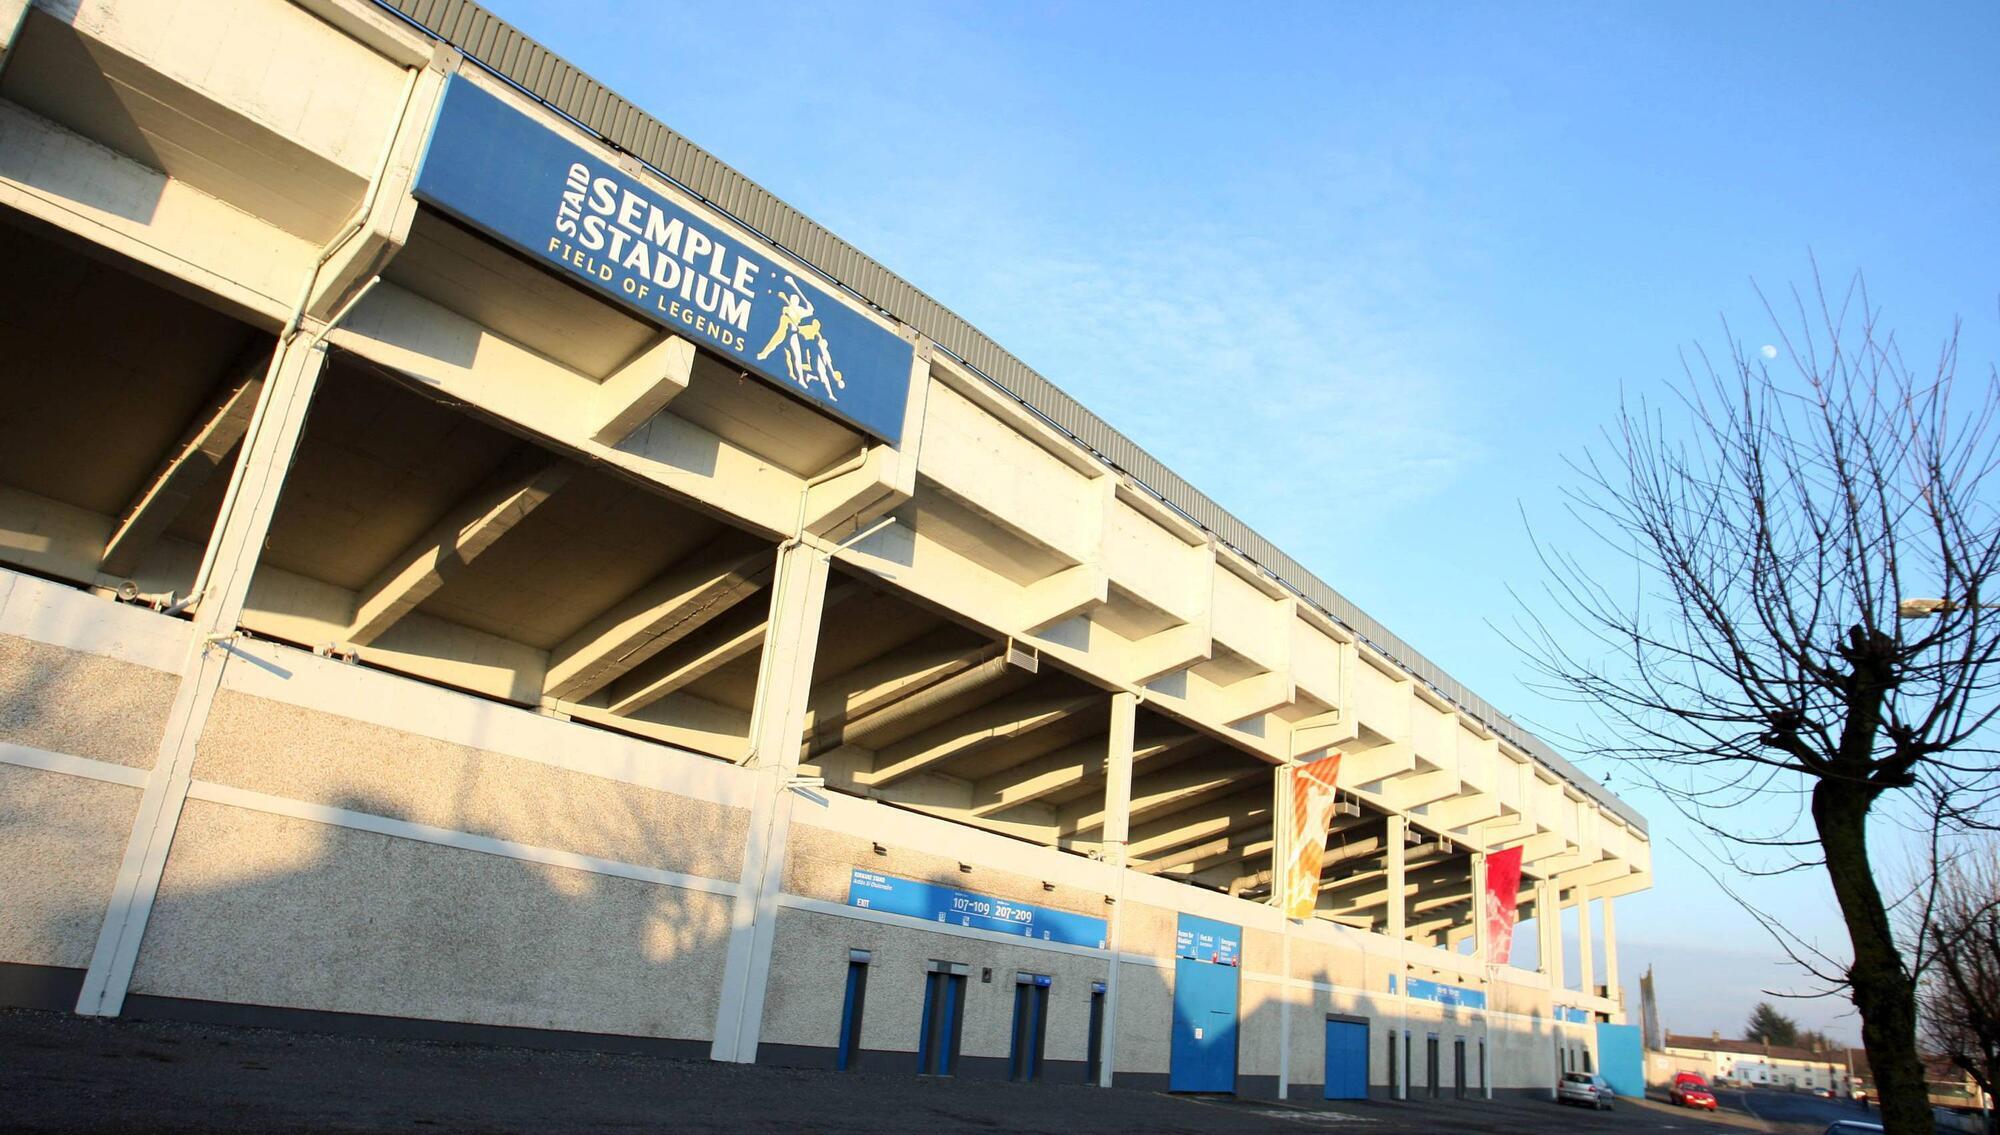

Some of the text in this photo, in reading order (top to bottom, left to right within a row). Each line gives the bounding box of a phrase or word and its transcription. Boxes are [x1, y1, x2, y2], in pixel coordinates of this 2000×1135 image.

[556, 163, 590, 237] STAID
[578, 216, 752, 332] STADIUM
[589, 177, 758, 298] SEMPLE
[548, 237, 746, 351] FIELD OF LEGENDS
[857, 898, 870, 908] EXIT
[953, 897, 990, 916] 107-109
[995, 905, 1032, 923] 207-209
